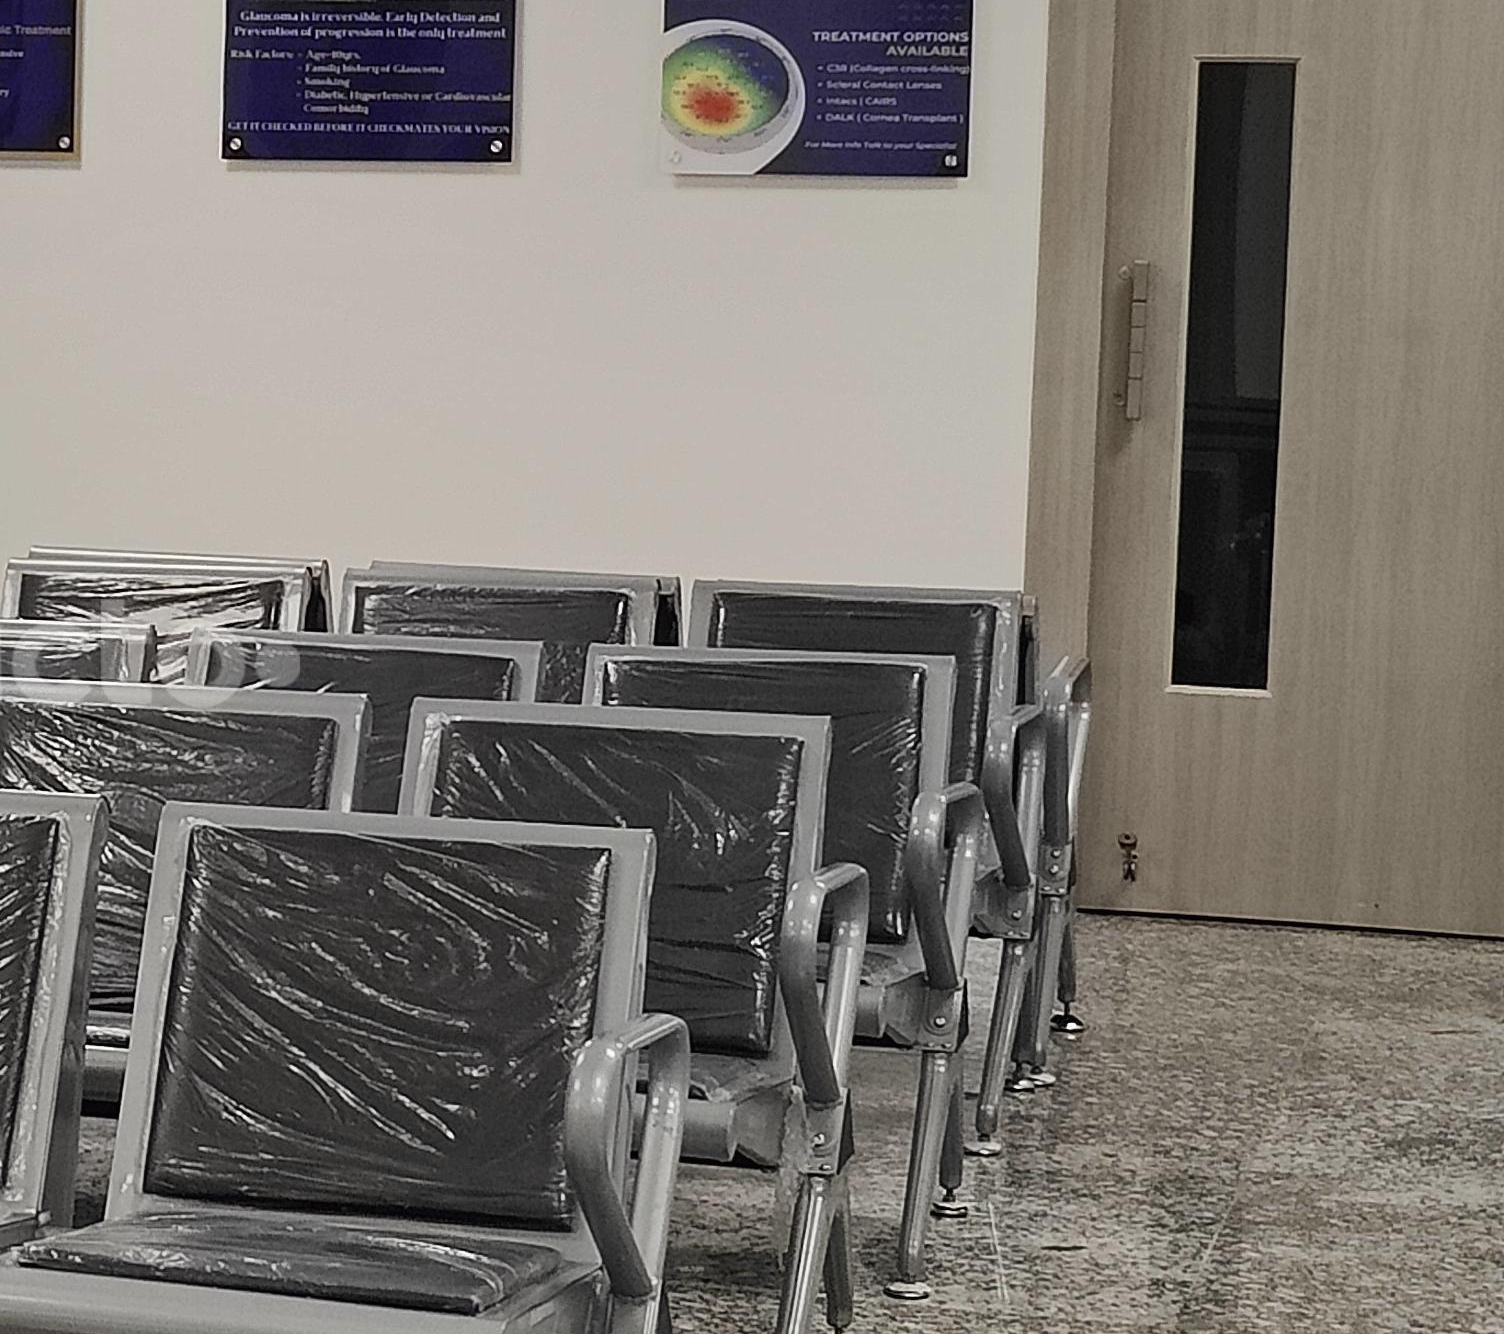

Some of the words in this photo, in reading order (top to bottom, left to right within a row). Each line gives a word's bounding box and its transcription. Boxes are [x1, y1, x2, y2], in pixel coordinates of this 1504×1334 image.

[240, 11, 298, 21] Glaucoma
[300, 11, 310, 21] is
[386, 11, 418, 24] Early
[420, 12, 475, 22] Detection
[478, 12, 500, 23] and
[14, 25, 71, 35] Treatment
[234, 26, 298, 37] Prevention
[300, 26, 312, 36] of
[315, 28, 384, 40] progression
[386, 28, 395, 37] is
[397, 27, 416, 37] the
[418, 27, 445, 40] only
[447, 28, 506, 38] treatment
[812, 31, 899, 42] TREATMENT
[903, 32, 969, 43] OPTIONS
[886, 46, 968, 56] AVAILABLE
[392, 64, 445, 74] Glaucoma
[304, 77, 350, 88] Smoking
[862, 80, 904, 89] Contact
[906, 81, 942, 89] Lenses
[825, 113, 854, 122] DALK
[863, 114, 900, 122] Cornea
[228, 121, 248, 131] GET
[261, 122, 312, 132] CHECKED
[314, 123, 353, 132] BEFORE
[442, 124, 472, 134] YOUR
